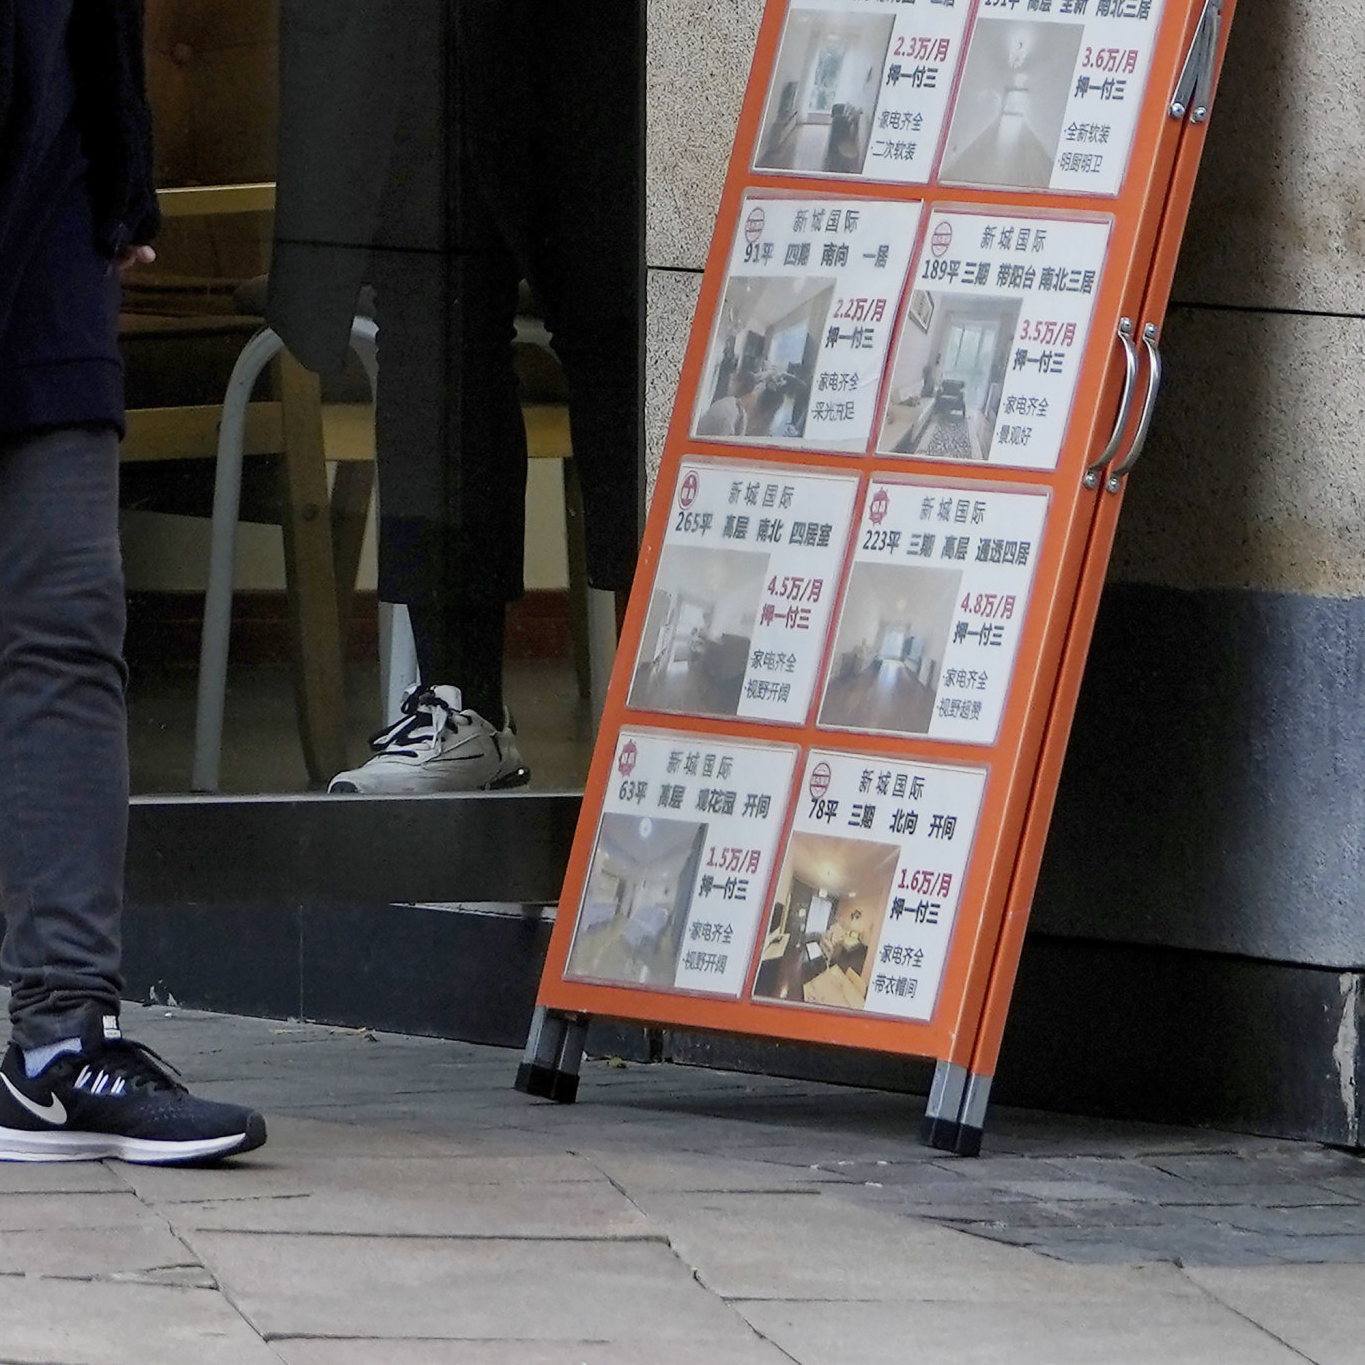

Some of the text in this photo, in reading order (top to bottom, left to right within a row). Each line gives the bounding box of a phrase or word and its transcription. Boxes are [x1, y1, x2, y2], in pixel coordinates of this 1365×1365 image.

[893, 35, 950, 63] 2.3万/月
[1082, 46, 1138, 74] 3.6万/月
[886, 64, 938, 88] 押一付三
[1075, 75, 1126, 100] 押一付三
[877, 111, 923, 132] 家电齐全
[792, 208, 860, 234] 新城国际
[980, 225, 1047, 254] 新城国际
[744, 242, 774, 267] 91平
[821, 242, 850, 267] 南向
[863, 245, 890, 270] 一居
[922, 260, 1096, 295] 189平 三期 带阳台 南北三居
[833, 297, 887, 322] 2.2万/月
[825, 325, 874, 349] 押一付三
[1020, 319, 1077, 346] 3.5万/月
[1013, 348, 1065, 374] 押一付三
[1004, 395, 1049, 417] 家电齐全
[728, 481, 795, 509] 新城国际
[919, 496, 987, 525] 新城国际
[675, 512, 713, 537] 265平
[723, 515, 750, 540] 高层
[789, 521, 832, 547] 四居室
[862, 530, 902, 555] 223平
[941, 535, 970, 561] 高层
[974, 537, 1031, 567] 通透四居
[767, 575, 824, 603] 4.5万/月
[760, 603, 811, 629] 押一付三
[960, 592, 1016, 620] 4.8万/月
[953, 620, 1005, 647] 押一付三
[750, 650, 797, 673] 家电齐全
[944, 668, 989, 691] 家电齐全
[666, 751, 734, 780] 新城国际
[858, 768, 926, 800] 新城国际
[619, 780, 649, 805] 63平
[658, 783, 686, 810] 高层
[742, 793, 772, 819] 开间
[808, 797, 958, 841] 78平 三期 北向 开间
[706, 846, 761, 874] 1.5万/月
[698, 874, 749, 901] 押一付三
[897, 868, 952, 898] 1.6万/月
[889, 895, 941, 925] 押一付三
[881, 944, 924, 968] 家电齐全
